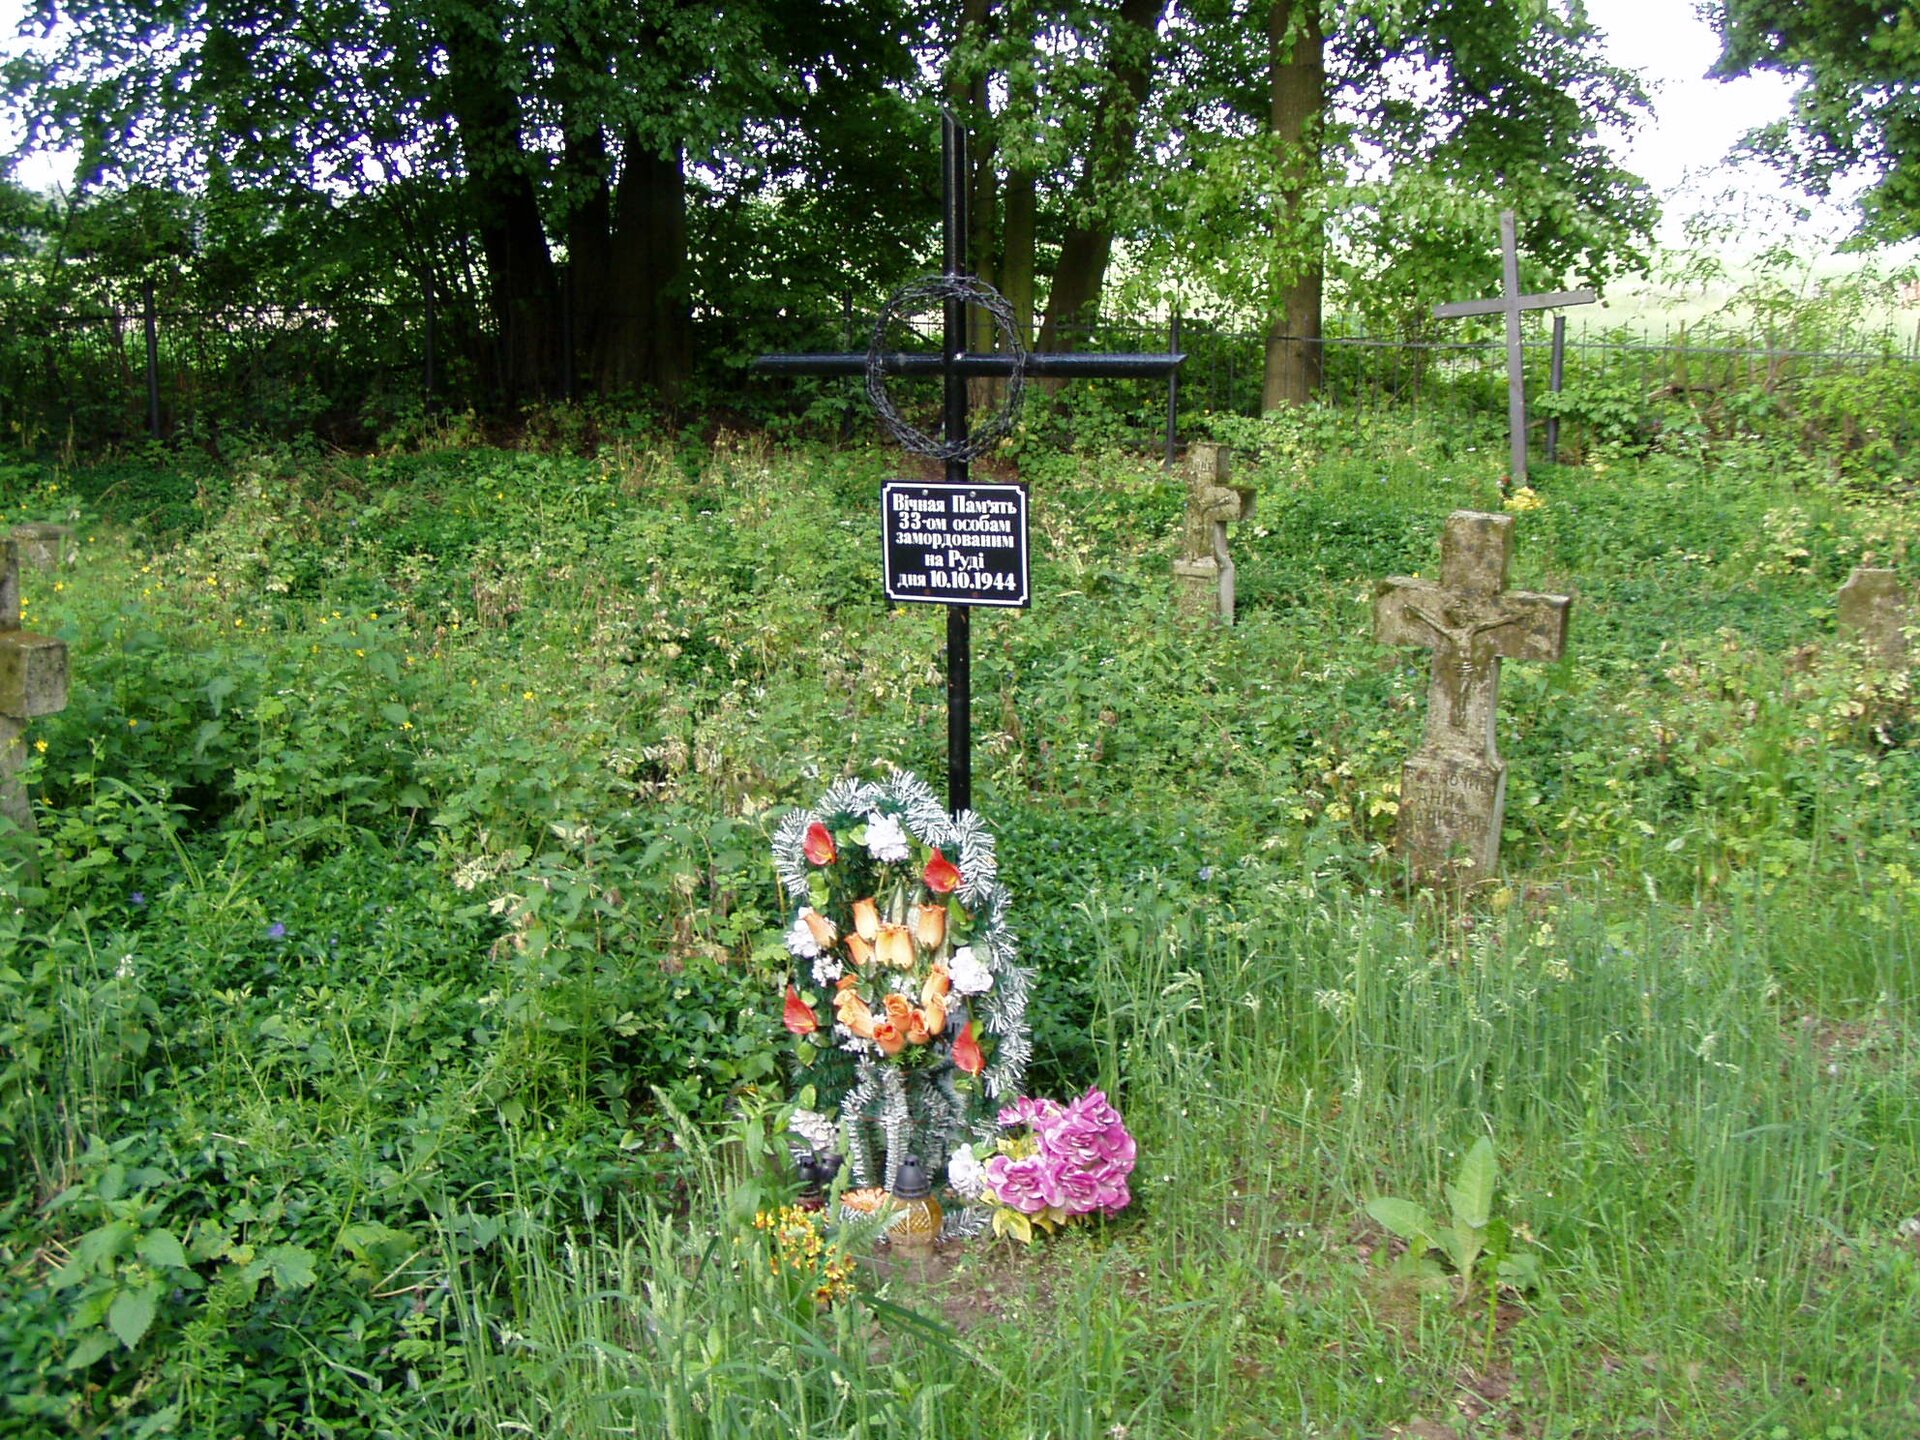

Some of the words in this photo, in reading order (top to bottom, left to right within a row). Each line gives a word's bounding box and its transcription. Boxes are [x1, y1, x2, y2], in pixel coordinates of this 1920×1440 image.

[892, 493, 946, 512] Вічная
[898, 511, 947, 531] 33-ом
[952, 514, 1012, 533] особам
[895, 532, 1015, 549] замордованим
[924, 554, 944, 567] на
[948, 550, 985, 571] Руді
[897, 574, 926, 588] дня
[930, 571, 1016, 591] 10.10.1944
